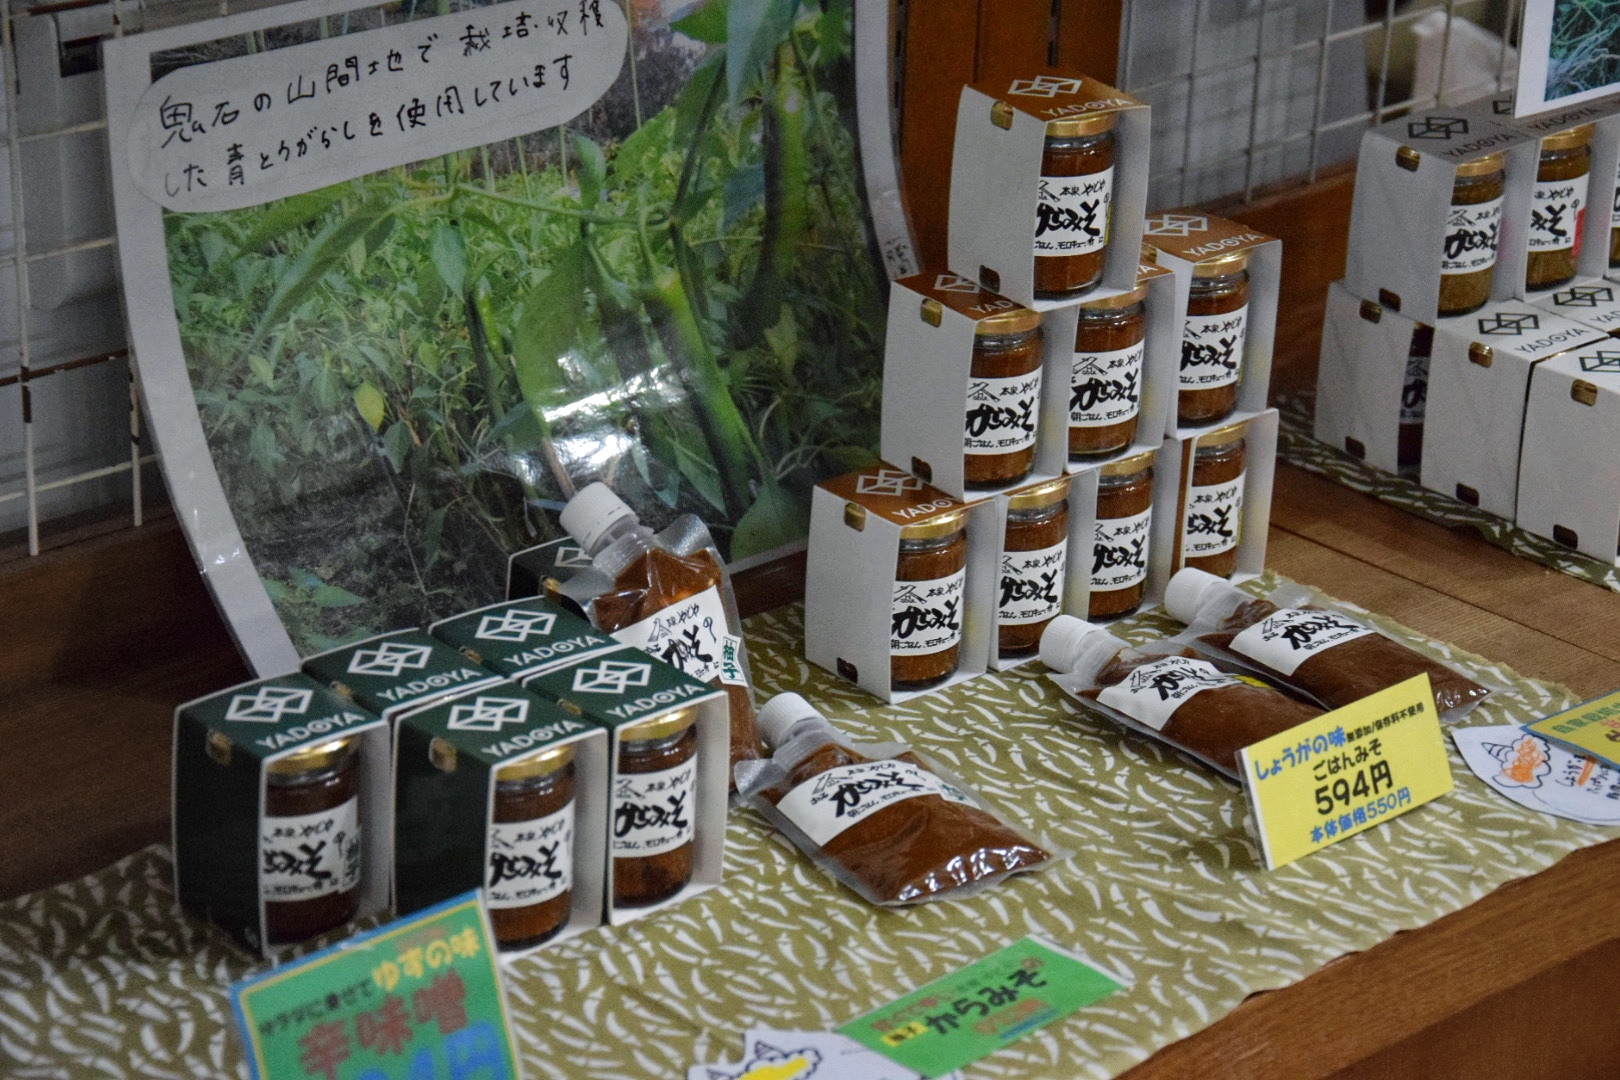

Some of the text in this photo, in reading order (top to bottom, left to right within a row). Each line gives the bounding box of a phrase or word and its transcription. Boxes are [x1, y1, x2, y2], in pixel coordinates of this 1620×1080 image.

[1040, 98, 1133, 117] YADOYA
[1443, 133, 1514, 158] YADOYA
[1182, 233, 1264, 257] YADOYA
[968, 299, 1014, 314] YAD
[1515, 327, 1591, 353] YADOYA
[892, 498, 953, 520] YADO
[503, 634, 607, 667] YADOYA
[376, 666, 482, 702] YADOYA
[606, 683, 705, 719] YADOYA
[255, 711, 367, 752] YADOYA
[482, 719, 587, 757] YADOYA
[1255, 702, 1424, 781] しょうがの味 無添加/保存料不使用
[1313, 738, 1382, 781] ごはんみそ
[1315, 760, 1393, 815] 594円
[1311, 786, 1412, 843] 本体価格550円
[372, 927, 480, 992] ゆずの味
[925, 969, 1047, 1034] からみそ
